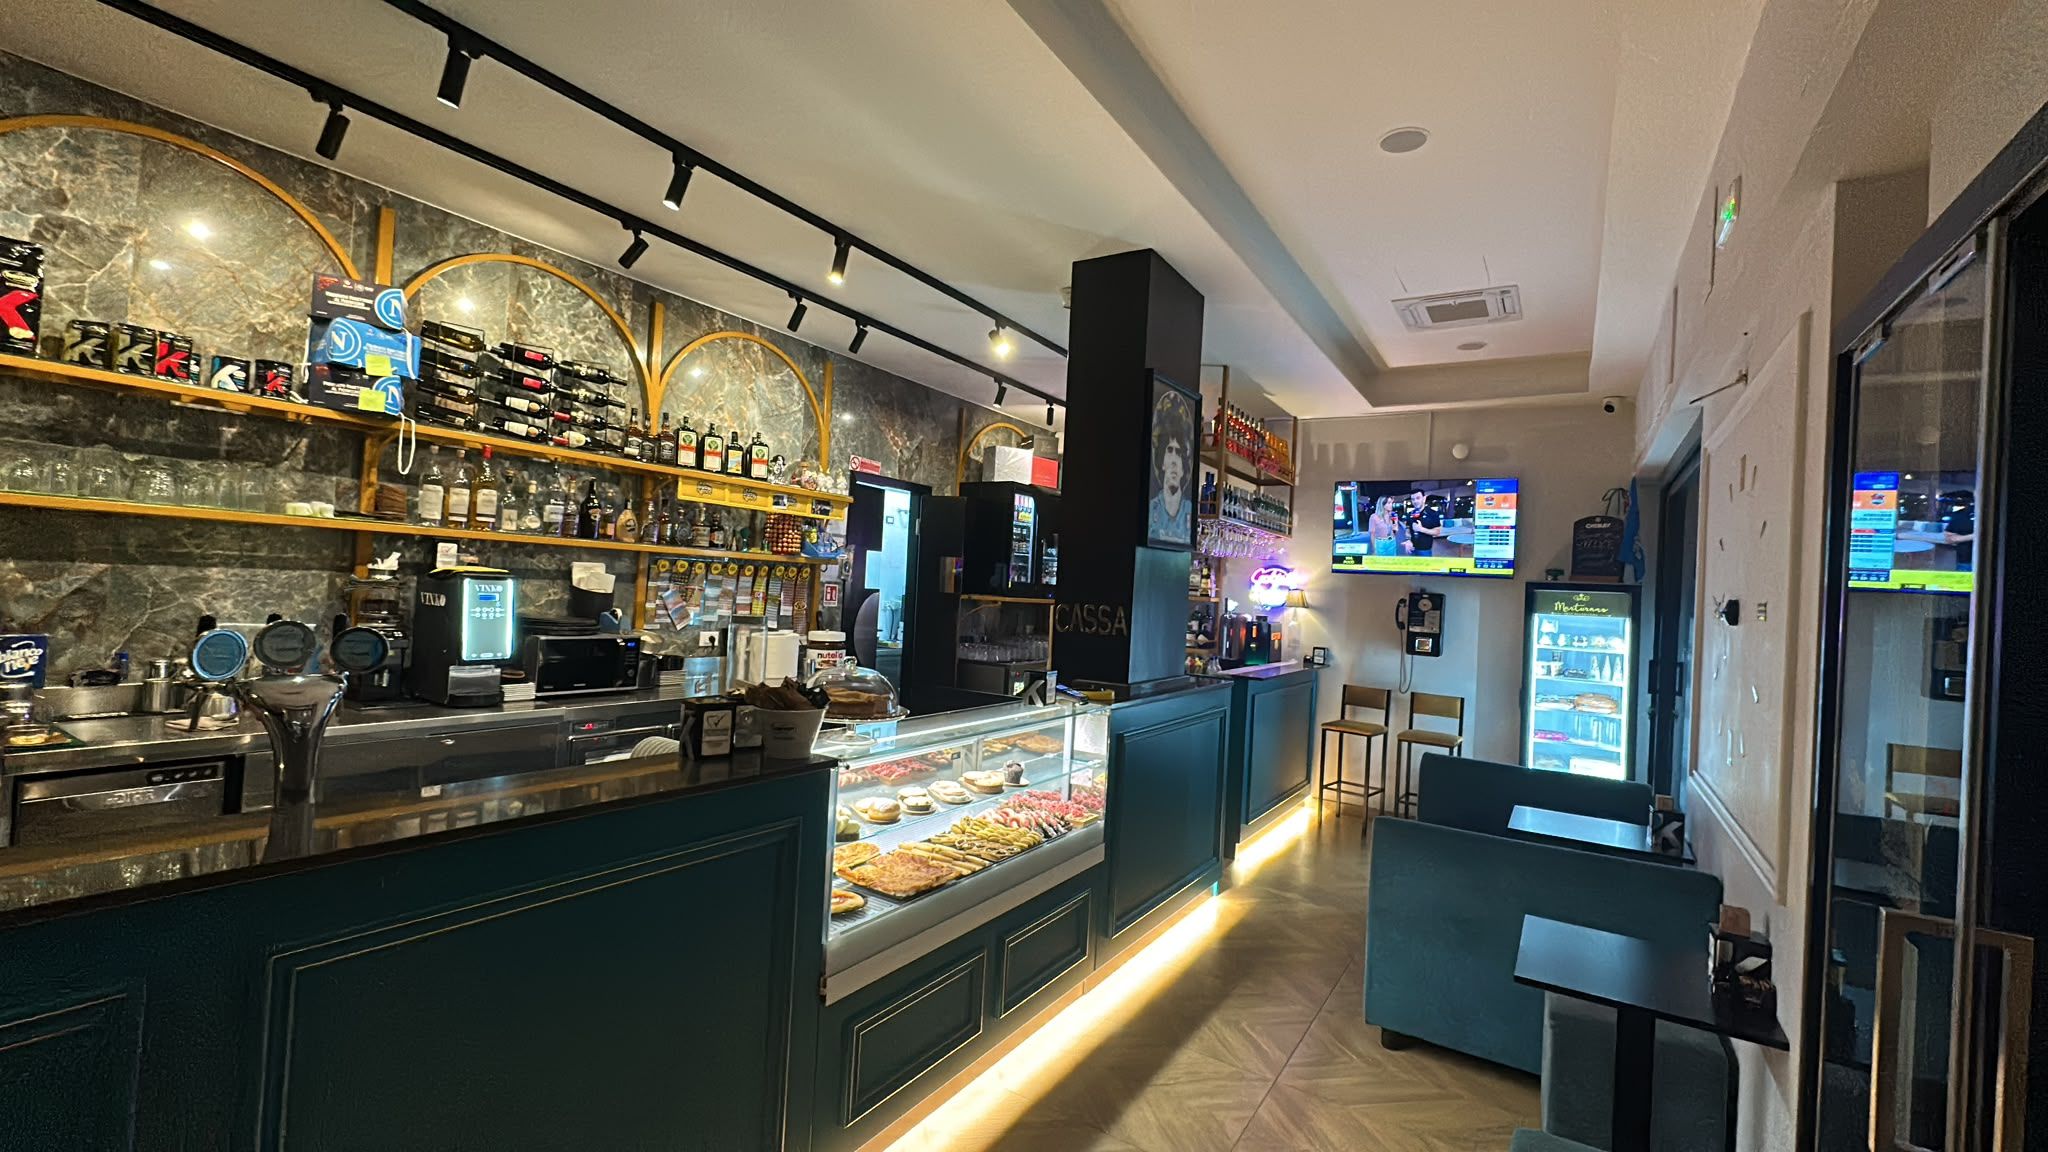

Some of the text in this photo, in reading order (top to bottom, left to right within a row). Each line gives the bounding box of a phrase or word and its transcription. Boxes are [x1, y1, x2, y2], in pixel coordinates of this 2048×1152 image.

[330, 330, 347, 350] N
[154, 340, 190, 379] K
[1055, 603, 1128, 636] CASSA
